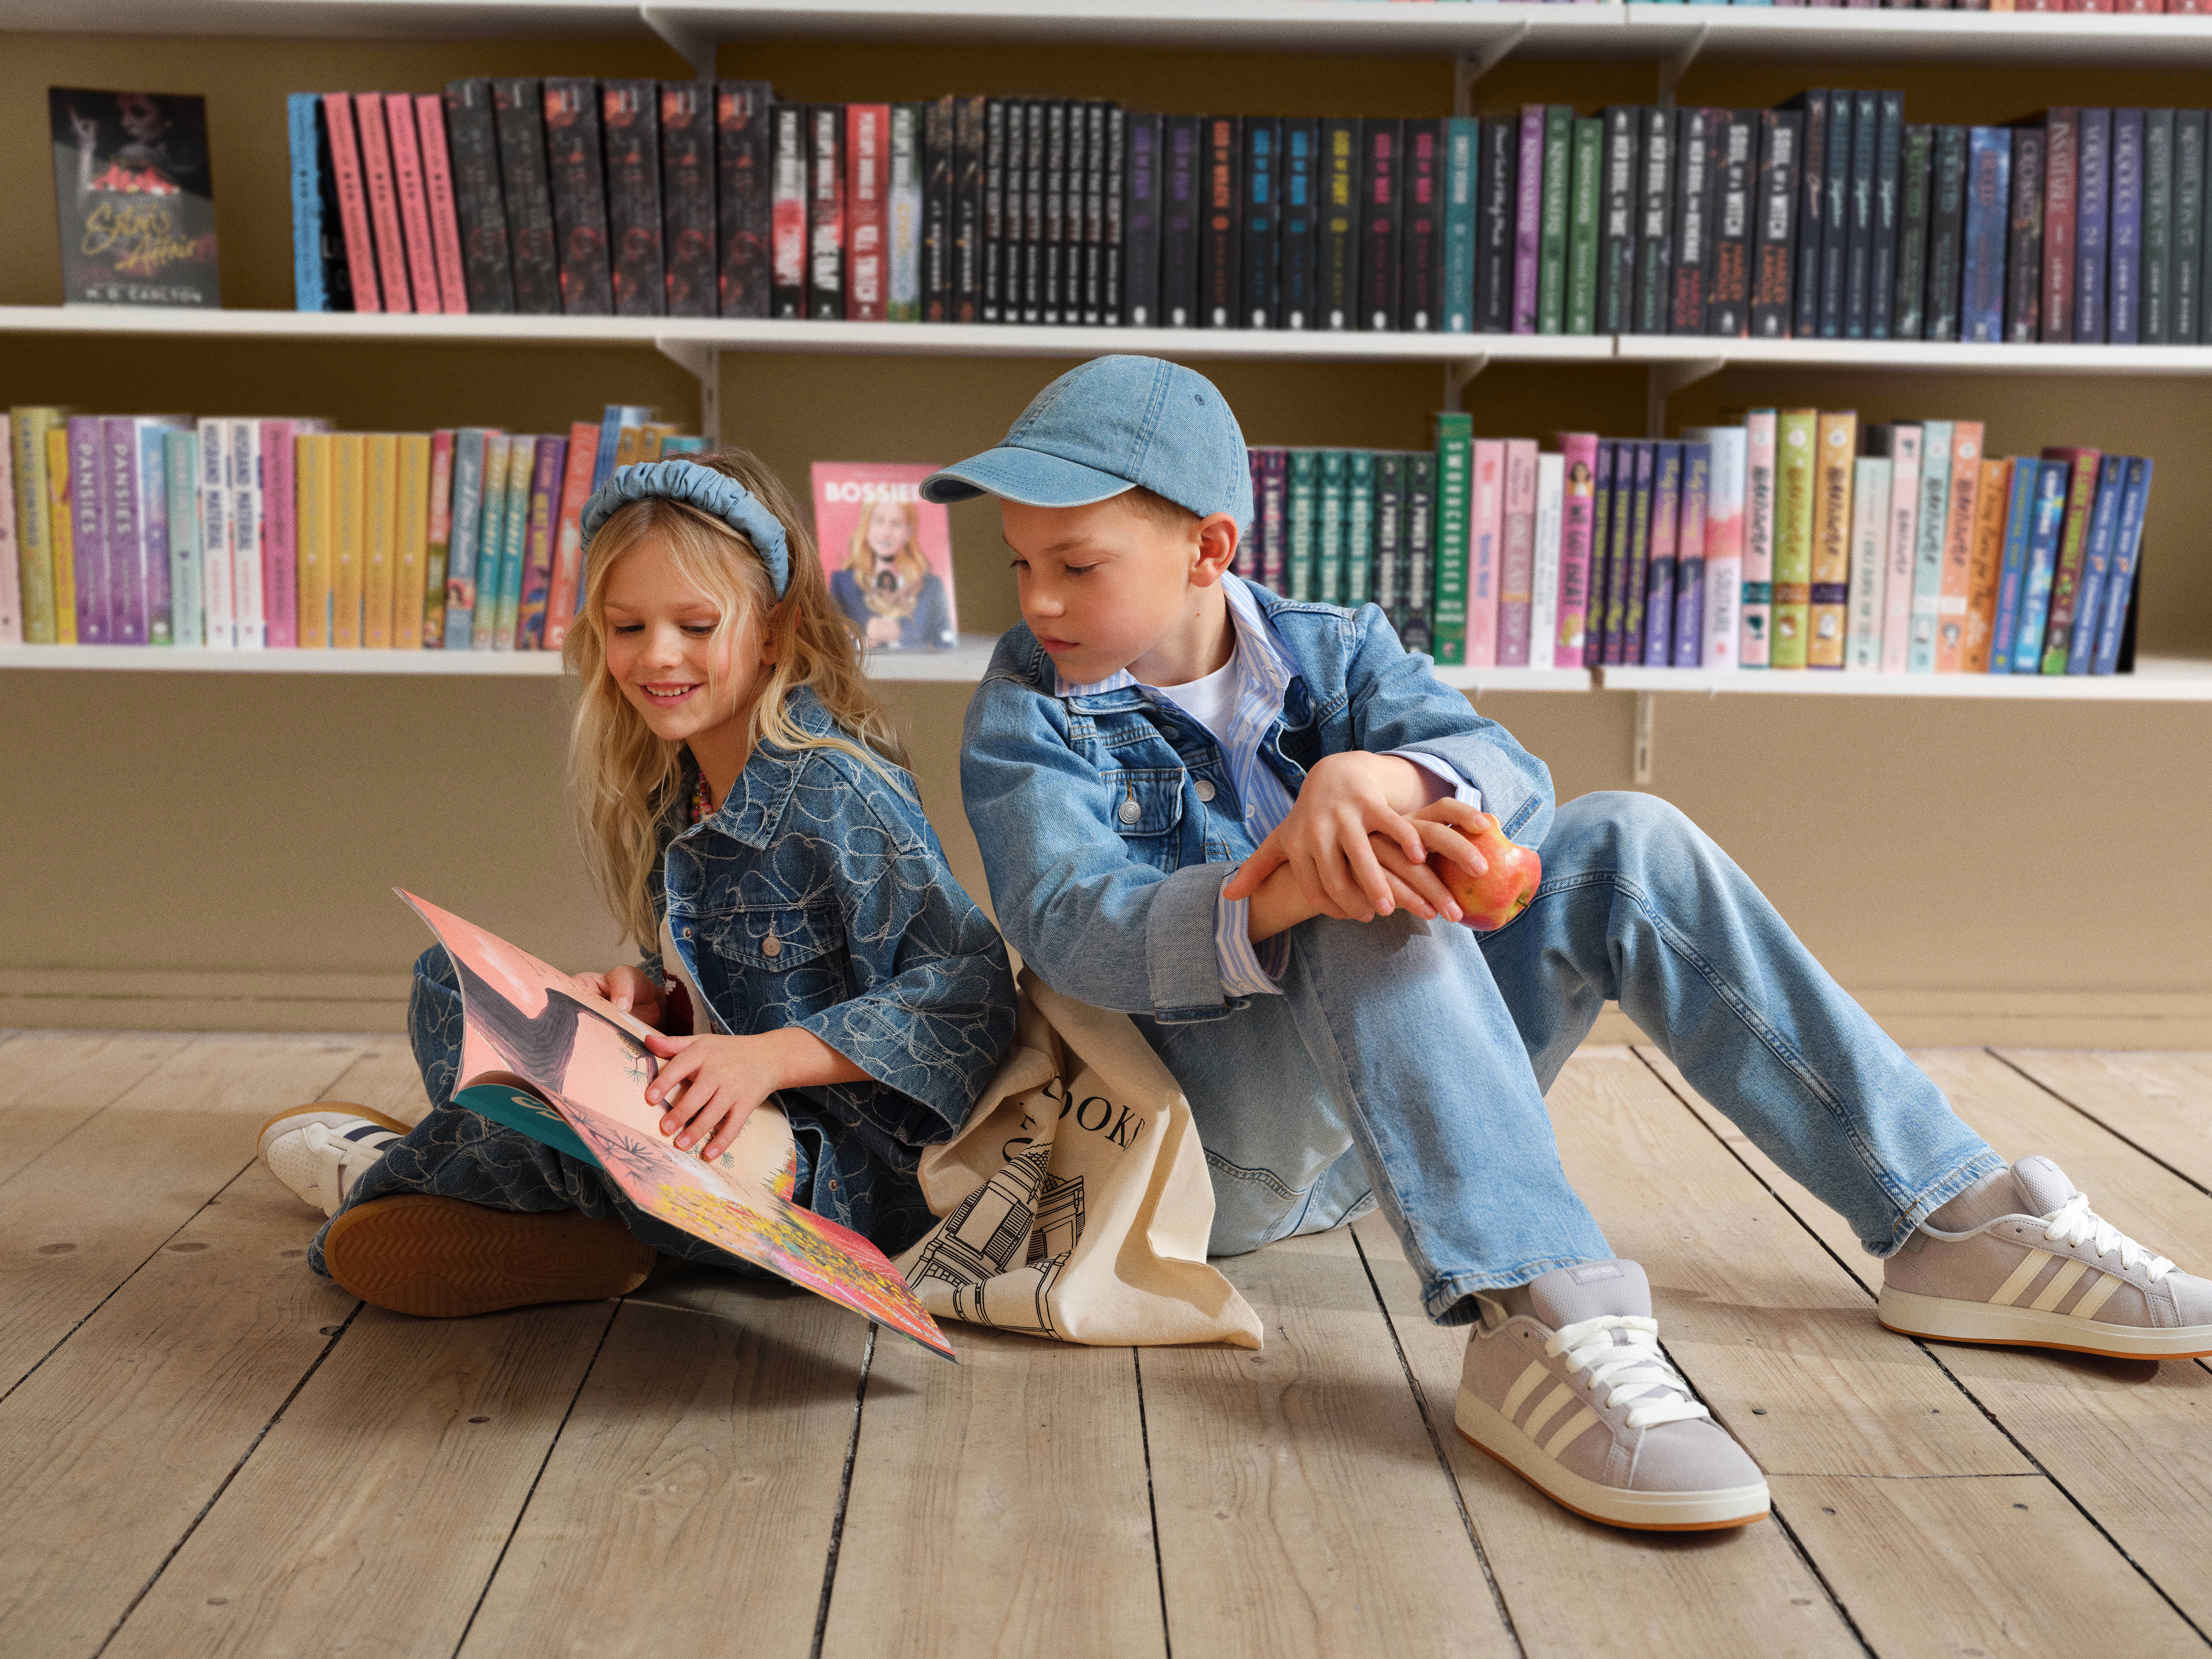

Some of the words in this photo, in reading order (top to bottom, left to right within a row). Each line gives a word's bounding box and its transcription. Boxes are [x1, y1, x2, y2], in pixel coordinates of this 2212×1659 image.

[896, 202, 911, 296] credence
[203, 423, 221, 485] HUSBAND
[233, 424, 251, 485] HUSBAND
[78, 443, 95, 534] PANSIES
[113, 443, 131, 534] PANSIES
[1444, 442, 1464, 592] SWORDCROSSED
[2074, 476, 2090, 506] LUCK
[206, 490, 224, 550] MATERIAL
[236, 491, 253, 550] MATERIAL
[1382, 507, 1395, 546] POWER
[1413, 507, 1426, 547] POWER
[2063, 511, 2086, 569] YOURSELF
